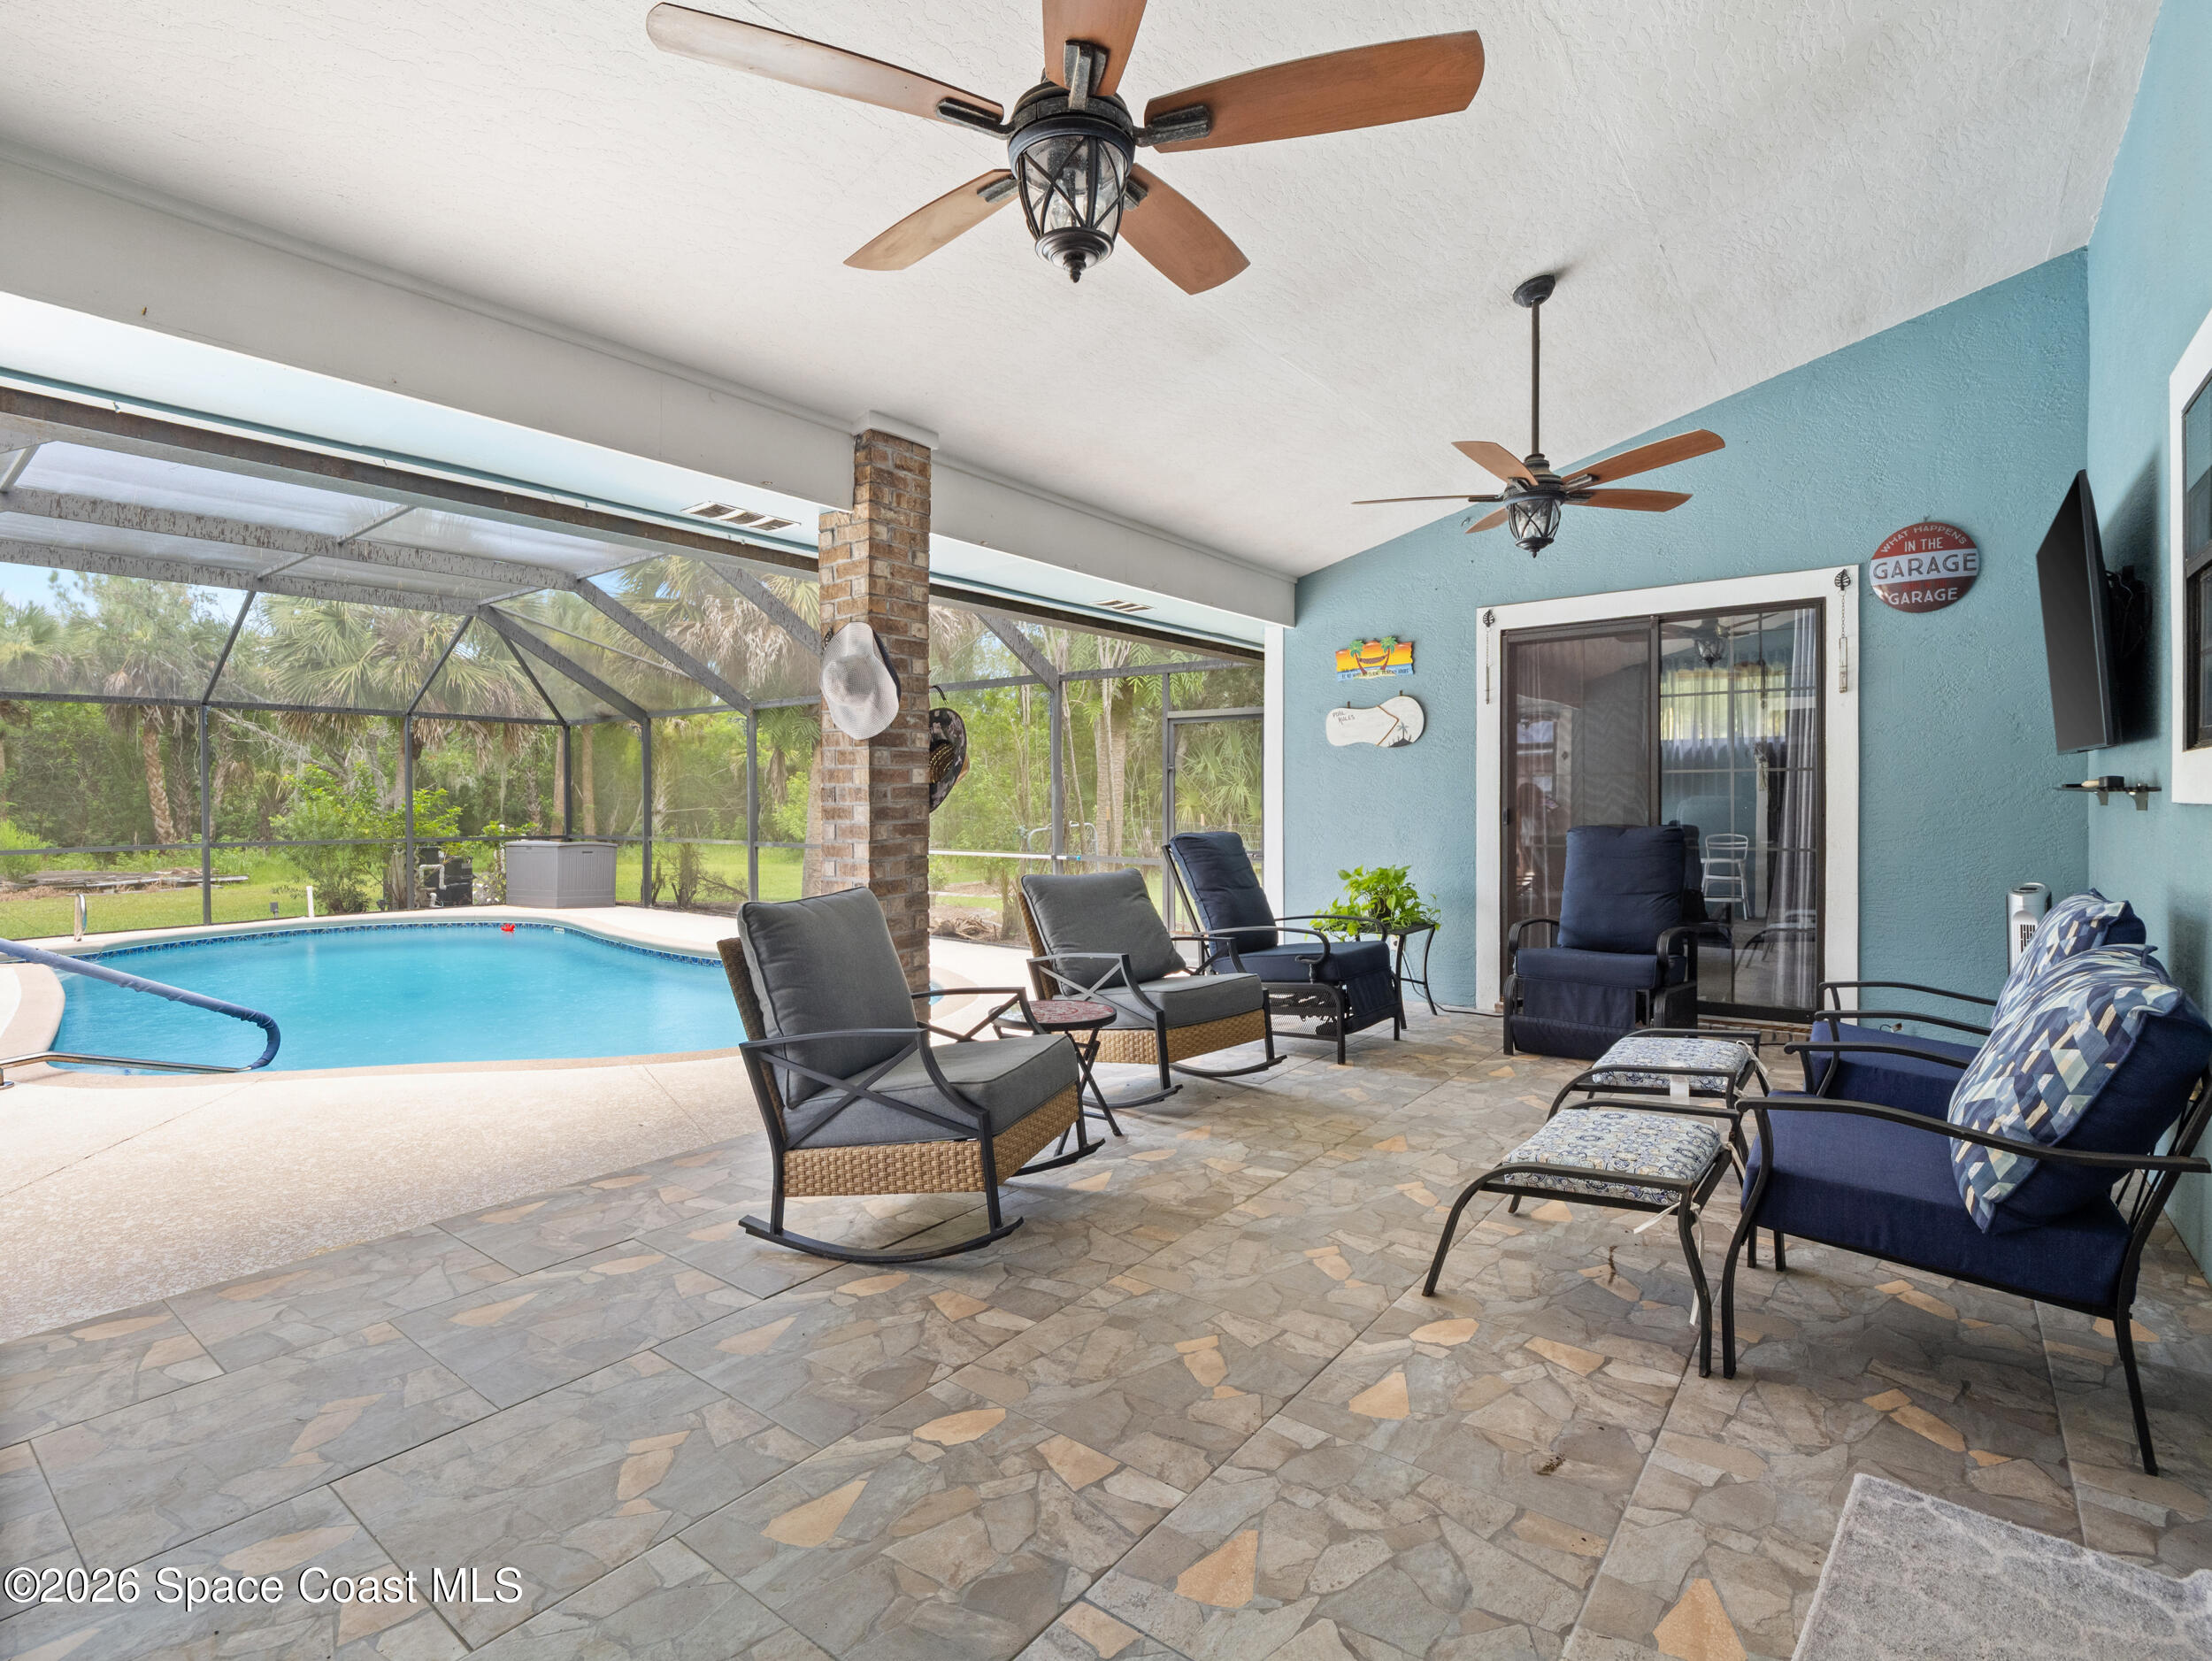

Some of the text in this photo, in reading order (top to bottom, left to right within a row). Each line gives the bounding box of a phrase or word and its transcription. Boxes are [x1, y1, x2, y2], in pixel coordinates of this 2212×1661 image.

[1880, 525, 1967, 553] WHAT HAPPENS
[1904, 536, 1944, 553] IN THE
[1872, 553, 1978, 580] GARAGE
[1887, 587, 1959, 606] GARAGE
